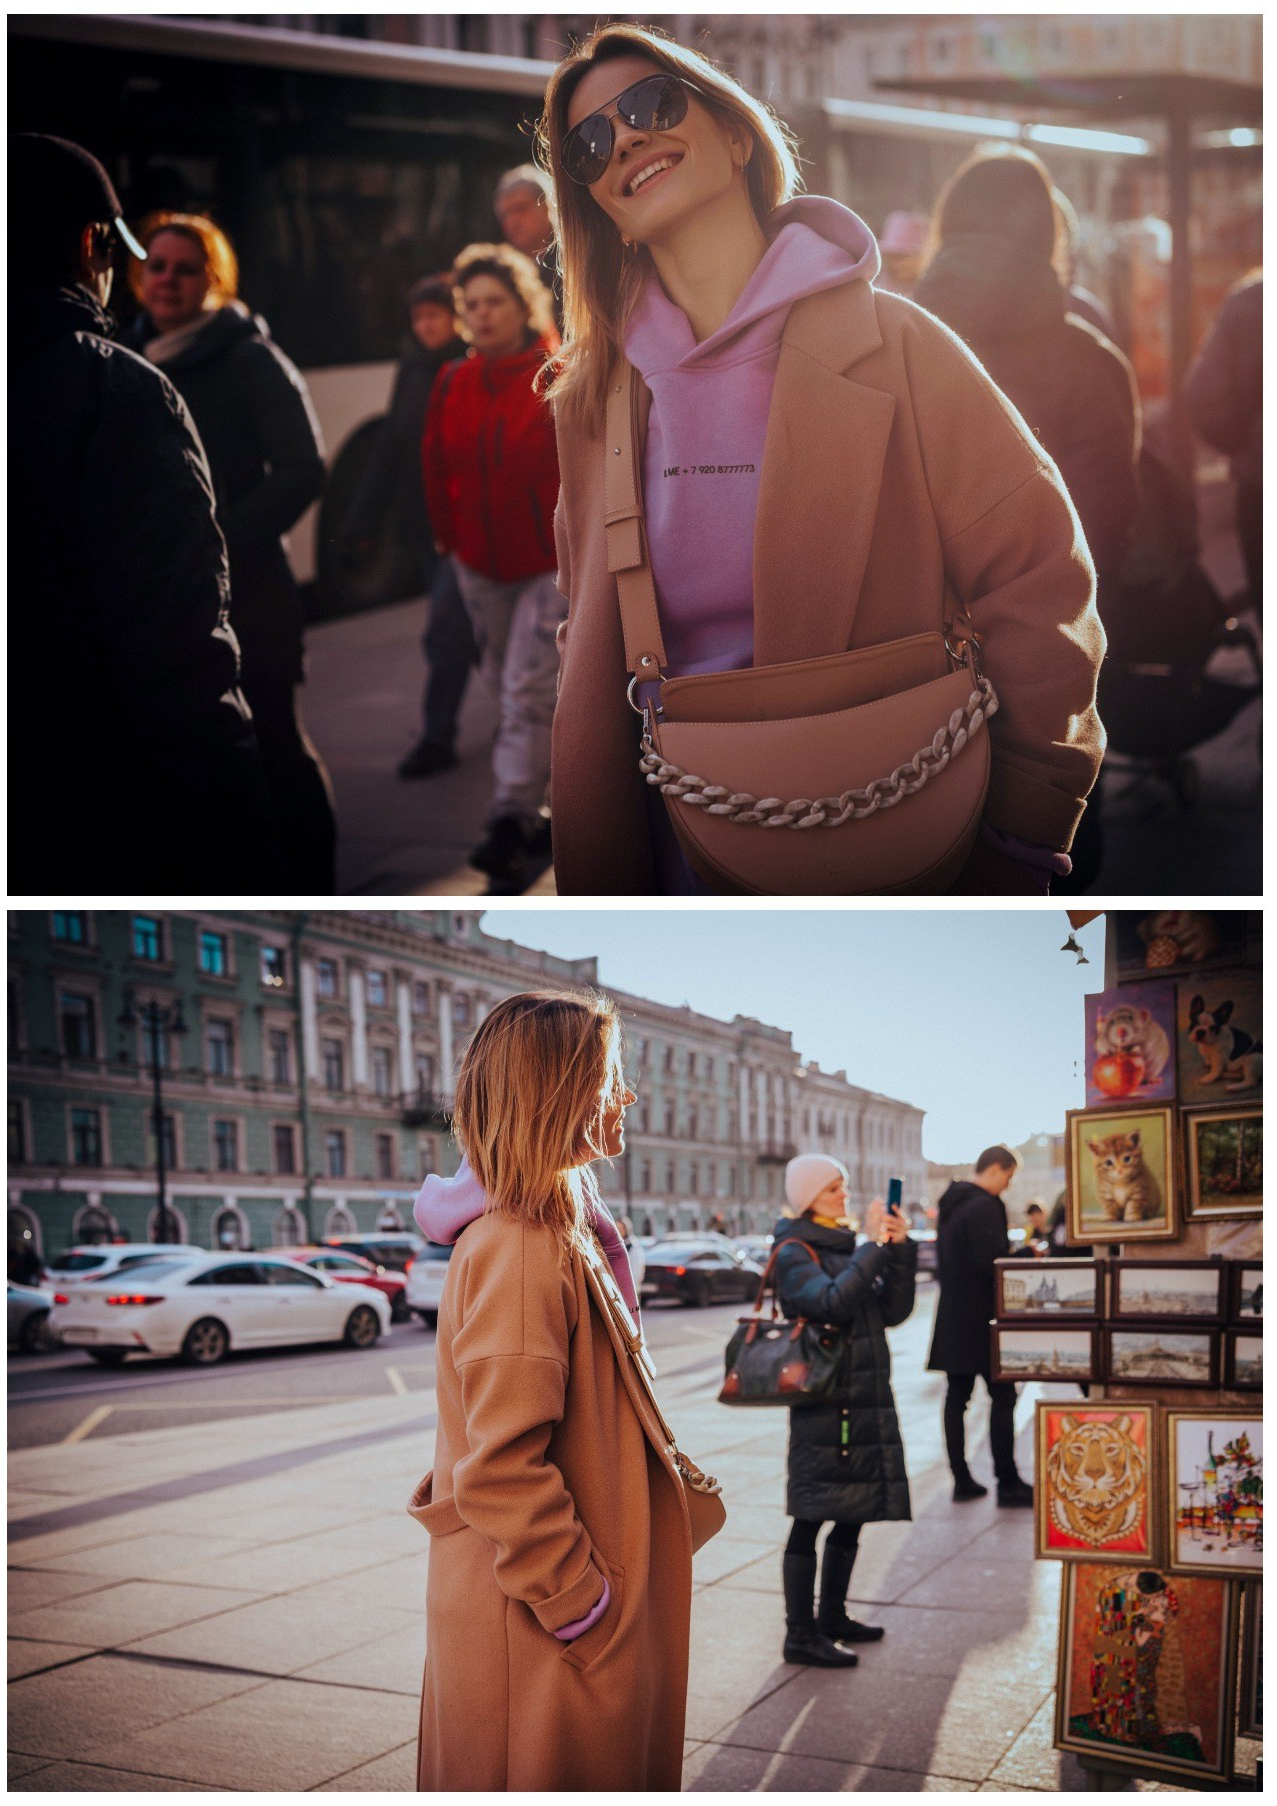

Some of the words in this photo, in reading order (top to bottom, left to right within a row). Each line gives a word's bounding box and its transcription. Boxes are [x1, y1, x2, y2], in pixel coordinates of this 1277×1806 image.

[668, 466, 680, 476] ME
[690, 466, 697, 474] 7
[699, 465, 716, 474] 920
[717, 464, 755, 474] 8777773
